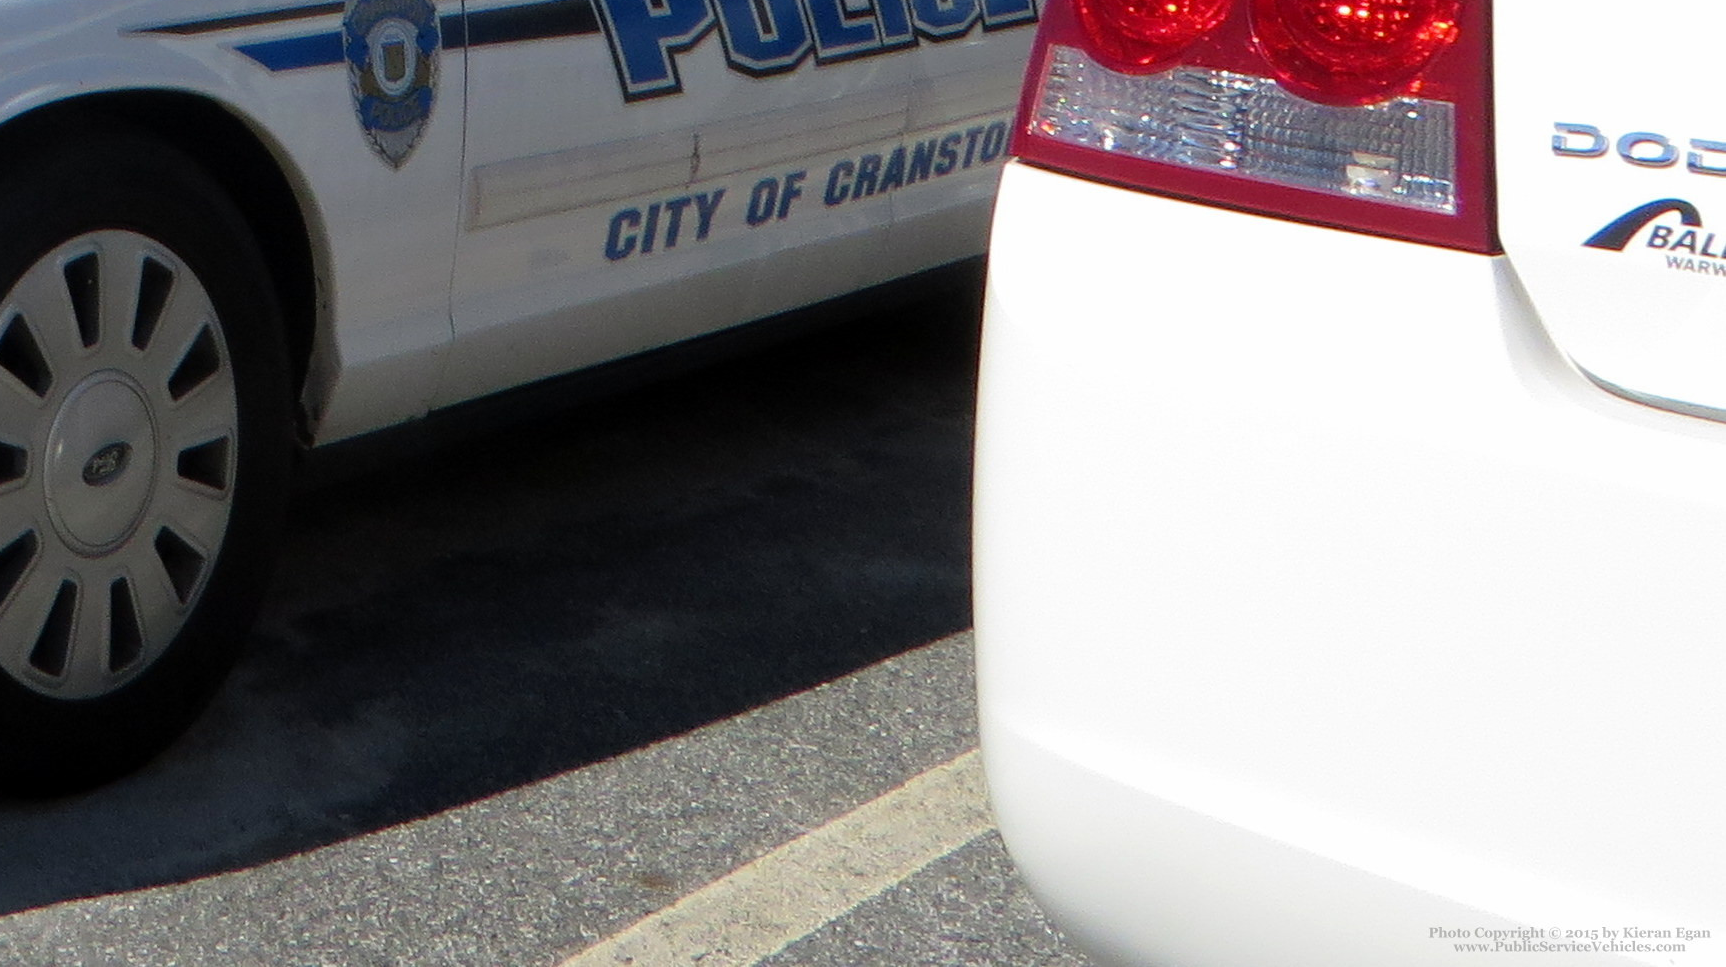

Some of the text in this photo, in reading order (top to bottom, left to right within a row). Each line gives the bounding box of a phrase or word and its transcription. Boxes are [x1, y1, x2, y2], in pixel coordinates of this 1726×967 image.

[604, 119, 1013, 262] CITY OF CRANSTO
